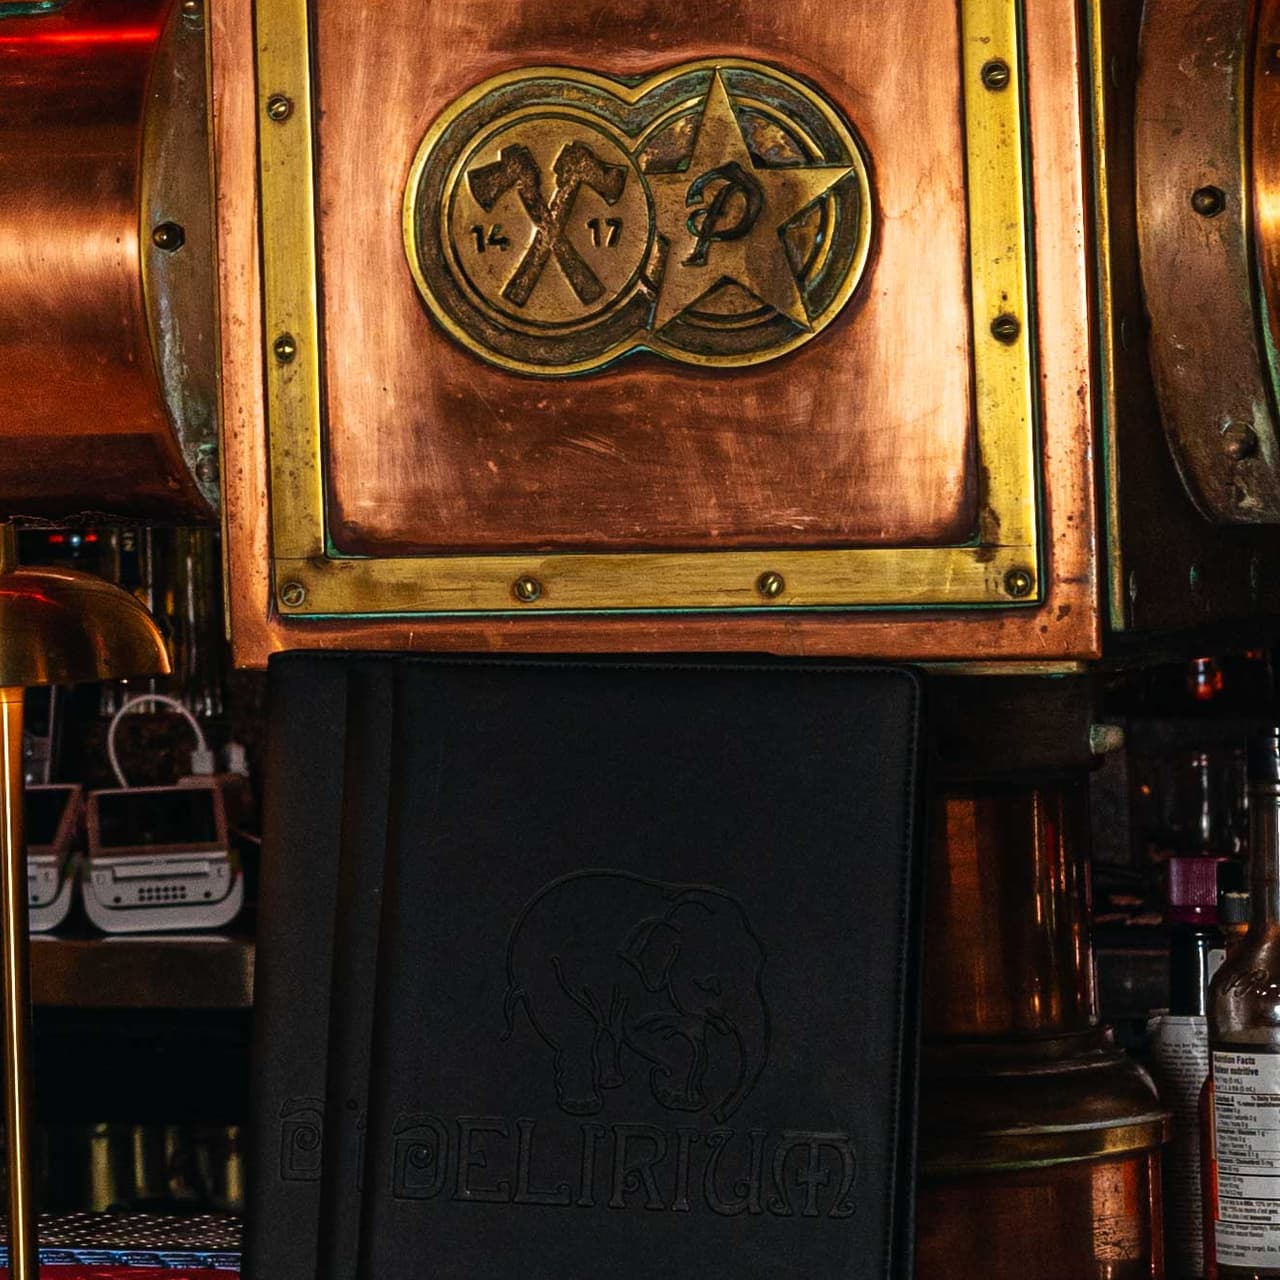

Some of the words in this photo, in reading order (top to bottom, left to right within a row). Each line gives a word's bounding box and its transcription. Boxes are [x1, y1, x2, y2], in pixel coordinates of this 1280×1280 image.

[470, 223, 509, 252] 14
[586, 218, 620, 248] 17
[393, 1113, 857, 1219] DELIRIUM
